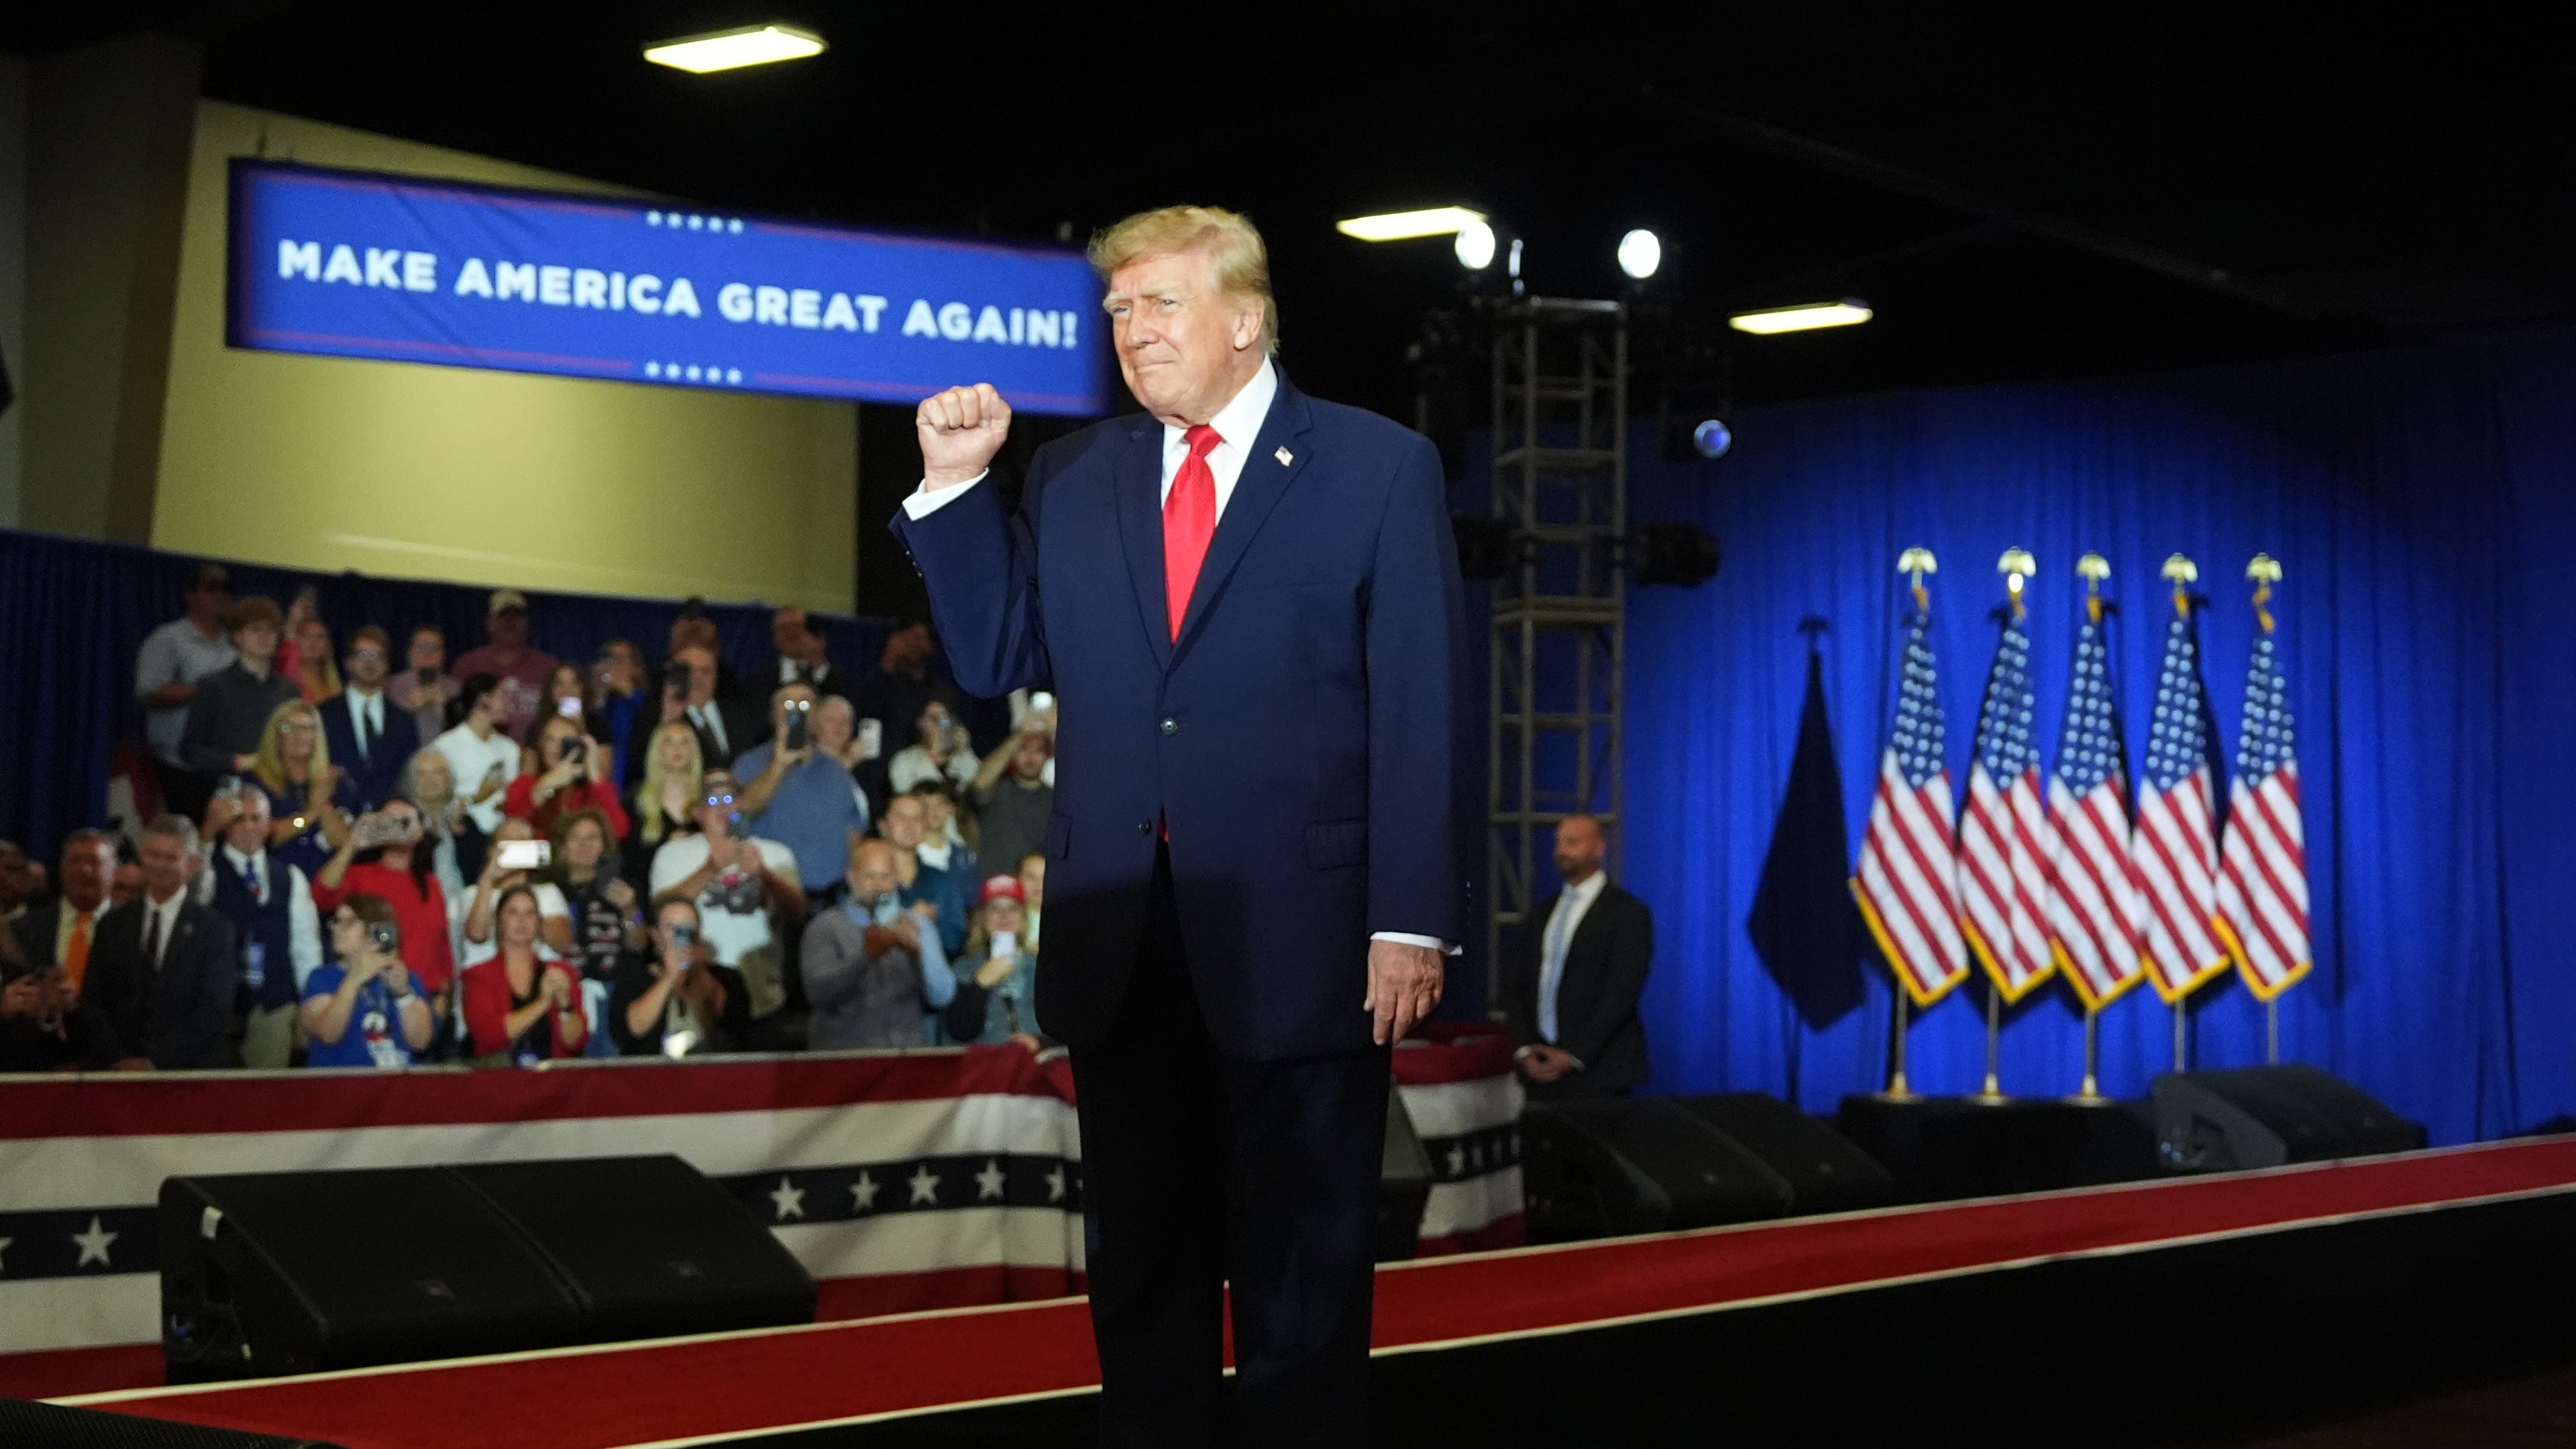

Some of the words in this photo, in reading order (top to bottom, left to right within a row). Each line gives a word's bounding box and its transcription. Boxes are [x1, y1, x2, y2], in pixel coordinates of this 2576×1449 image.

[278, 239, 437, 292] MAKE
[455, 258, 702, 318] AMERICA
[718, 282, 888, 333] GREAT
[902, 299, 1078, 348] AGAIN!
